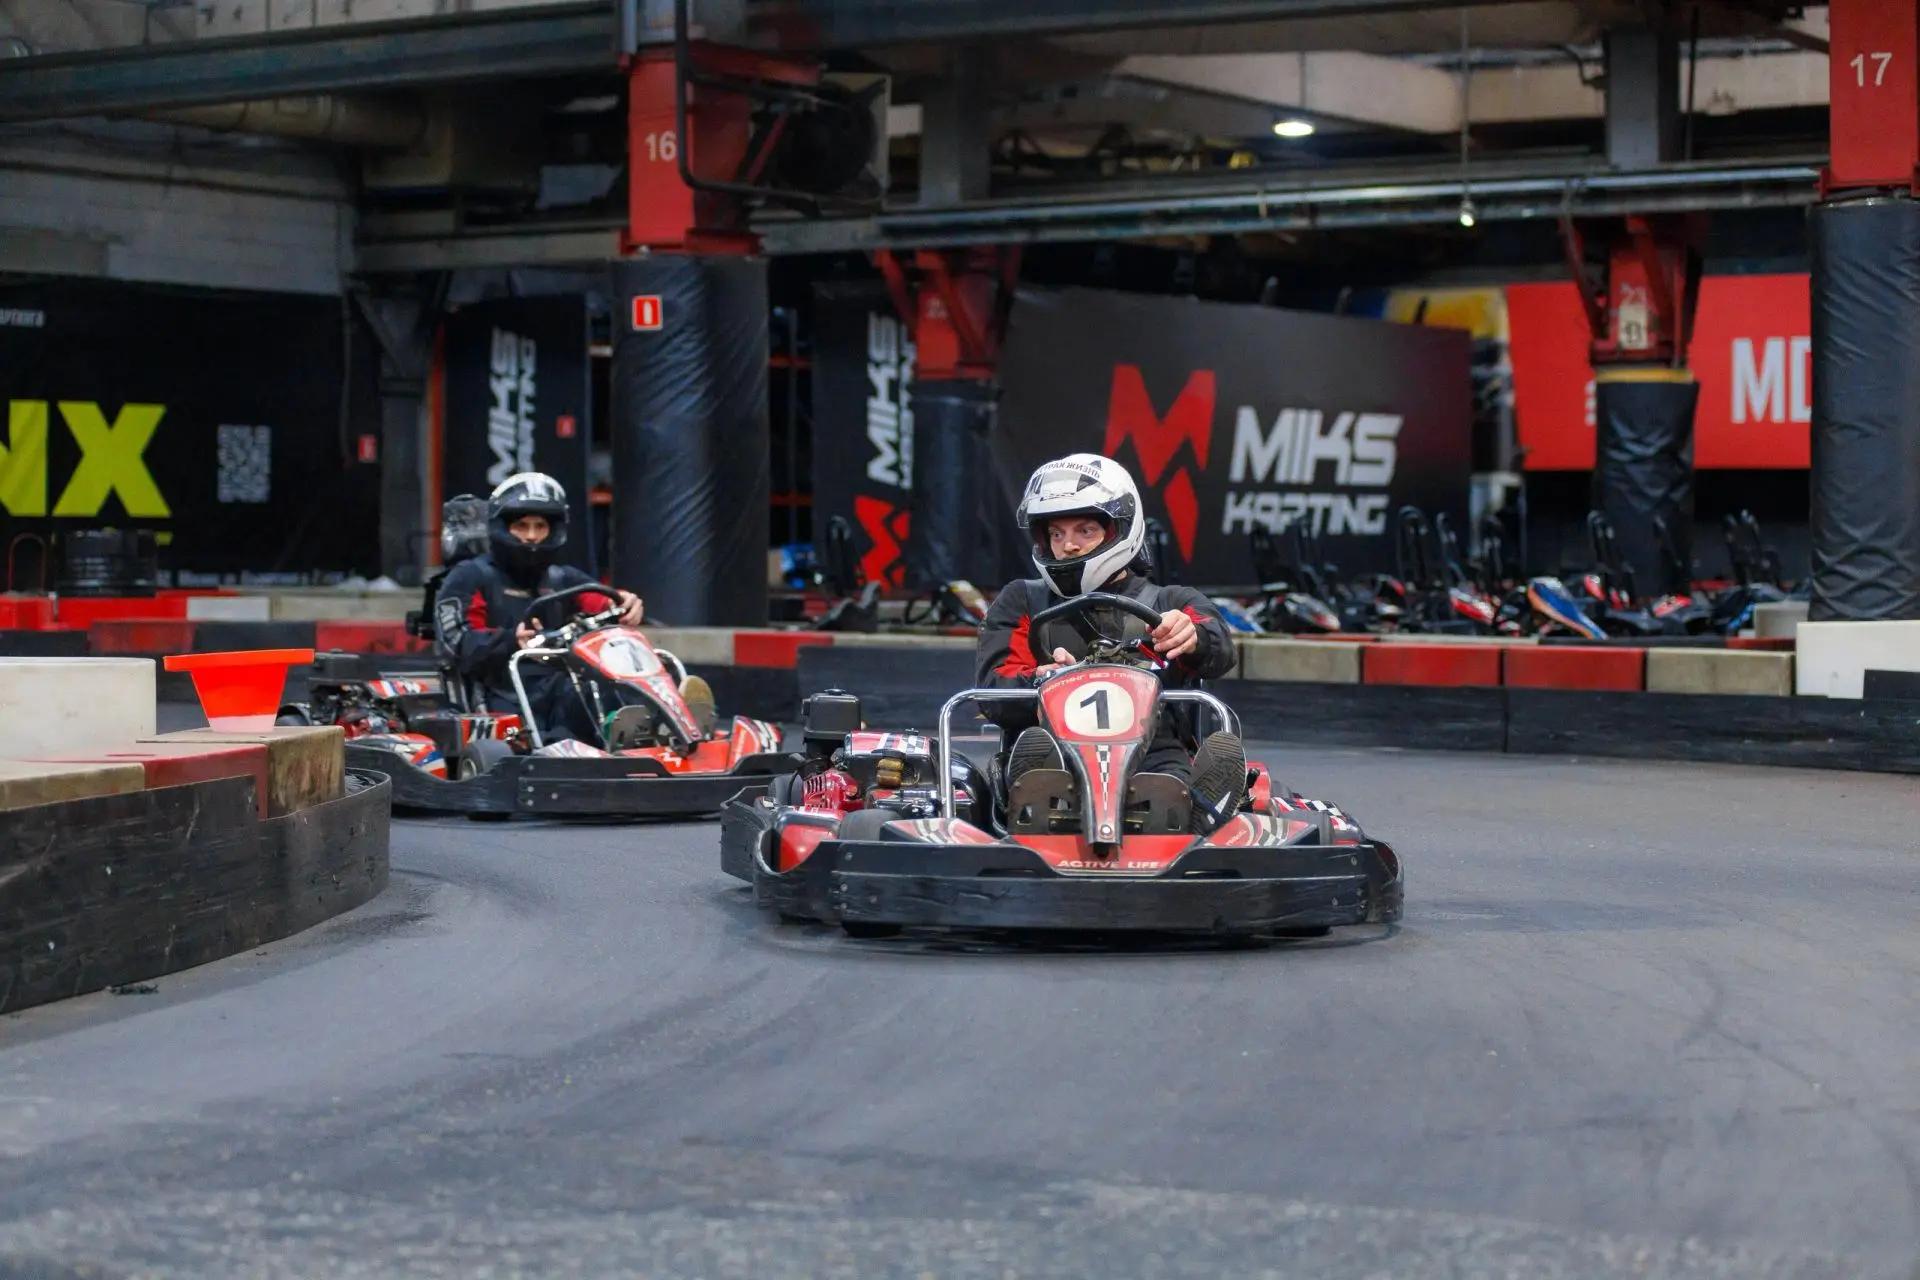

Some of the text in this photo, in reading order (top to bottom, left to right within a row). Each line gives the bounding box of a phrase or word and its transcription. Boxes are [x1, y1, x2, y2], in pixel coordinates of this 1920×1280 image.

[1850, 52, 1892, 87] 17
[645, 130, 677, 162] 16
[867, 312, 899, 486] MIKS
[1229, 405, 1404, 486] MIKS
[1222, 491, 1389, 537] KARTING
[1079, 689, 1110, 729] 1
[1056, 860, 1161, 869] ACTIVE LIFE
